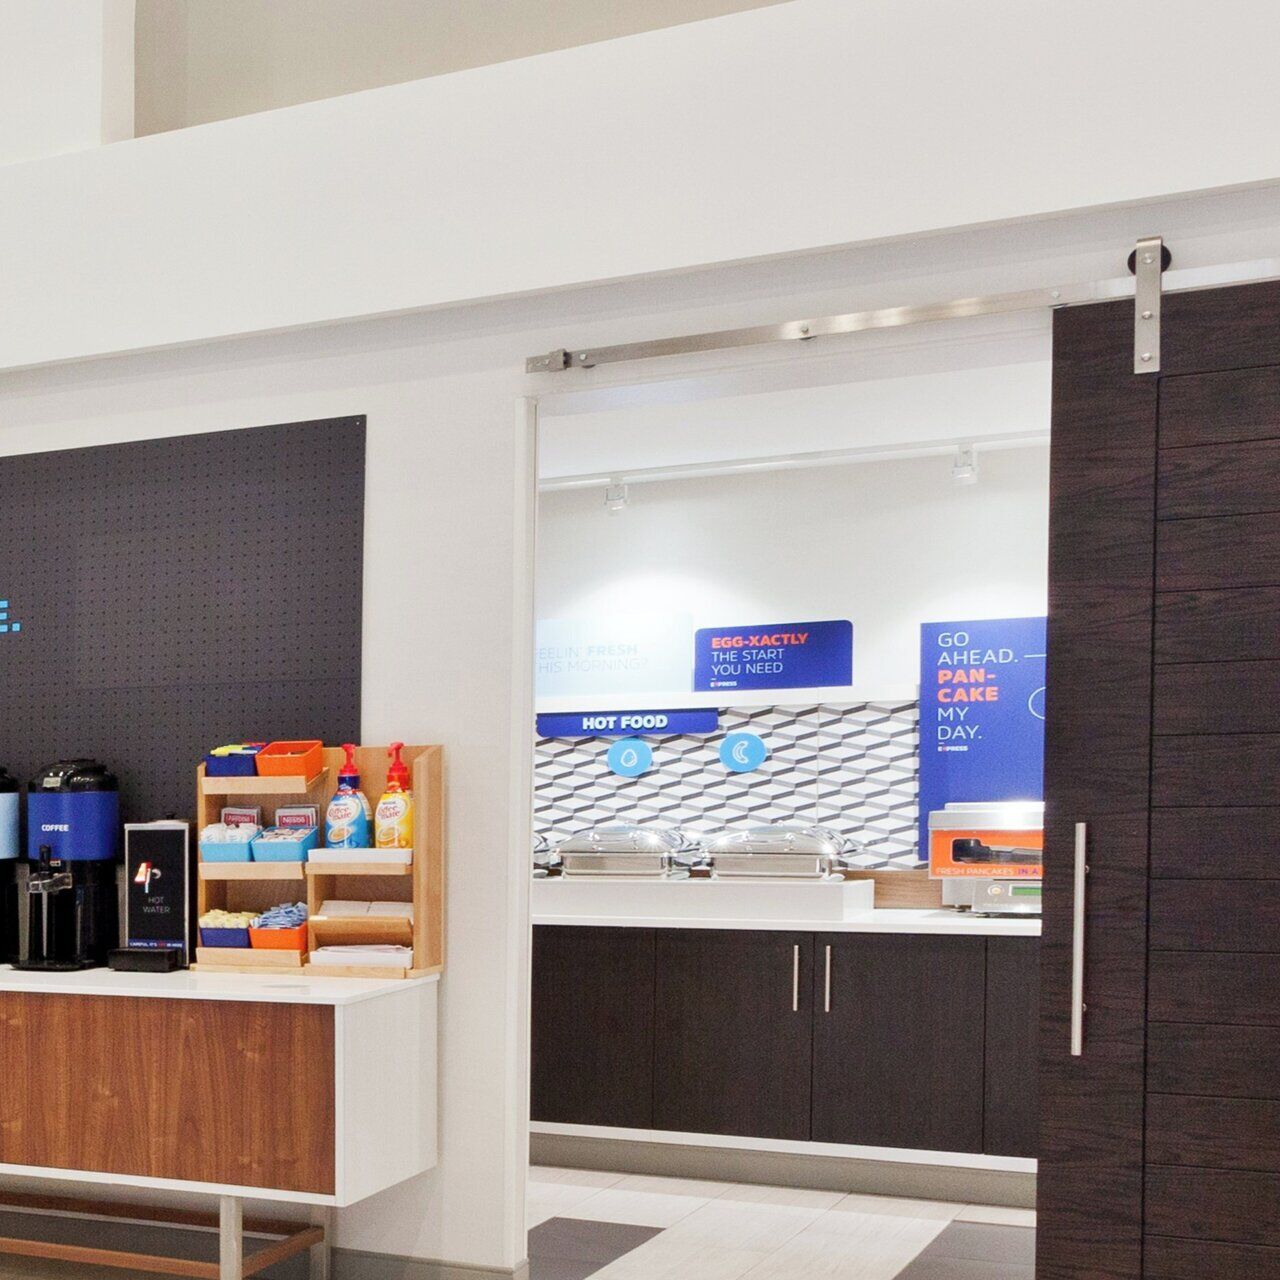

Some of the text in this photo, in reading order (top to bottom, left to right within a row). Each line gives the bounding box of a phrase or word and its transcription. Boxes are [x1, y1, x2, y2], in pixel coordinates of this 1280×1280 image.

[711, 633, 808, 649] EGG-XACTLY
[937, 631, 969, 647] GO
[712, 648, 785, 662] THE START
[937, 648, 1019, 665] AHEAD.
[712, 662, 784, 676] YOU NEED
[937, 667, 997, 684] PAN-
[937, 686, 999, 703] CAKE
[937, 706, 969, 721] MY
[582, 715, 668, 730] HOT FOOD
[937, 725, 982, 740] DAY.
[41, 824, 69, 832] COFFEE
[148, 896, 164, 904] HOT
